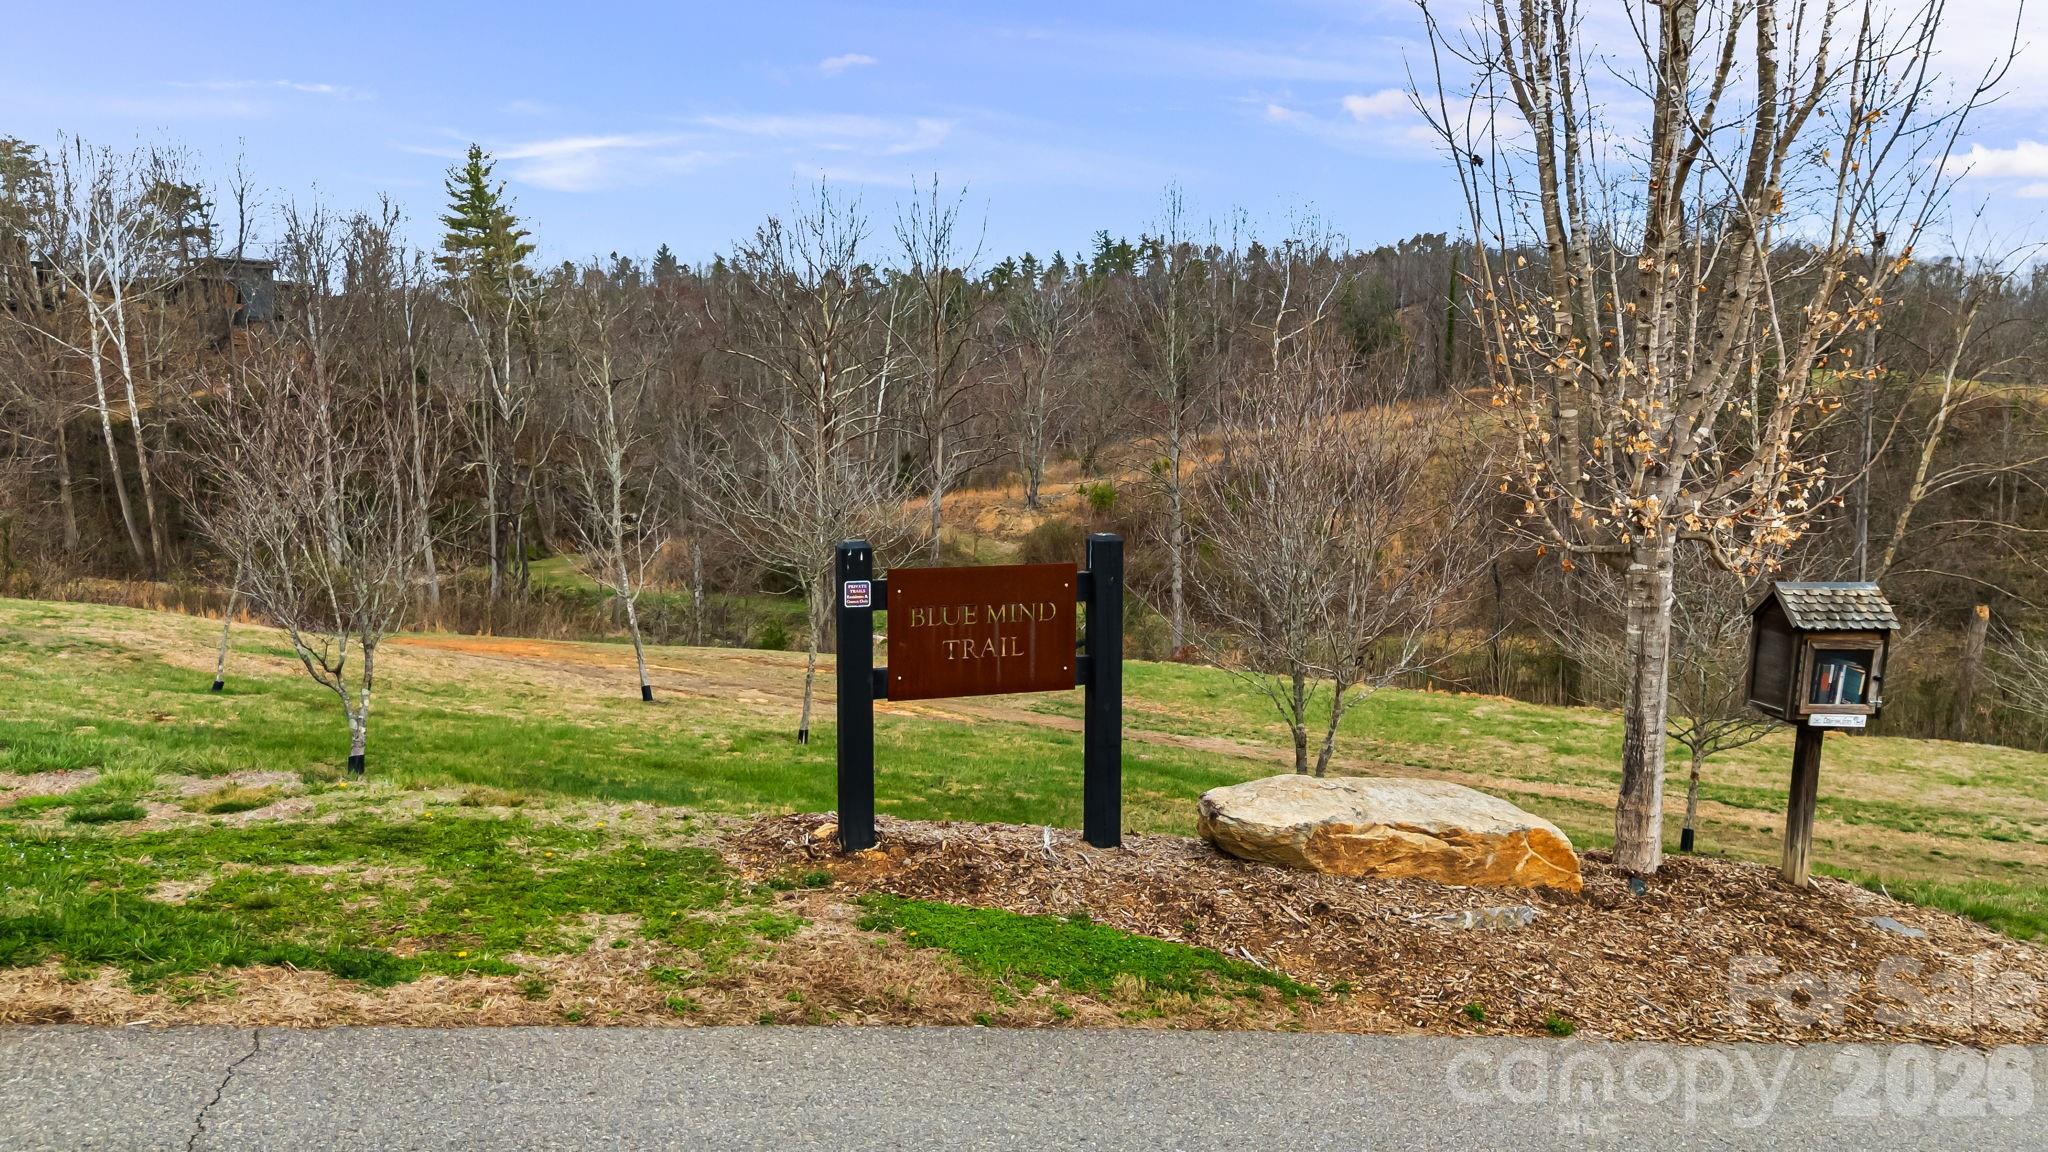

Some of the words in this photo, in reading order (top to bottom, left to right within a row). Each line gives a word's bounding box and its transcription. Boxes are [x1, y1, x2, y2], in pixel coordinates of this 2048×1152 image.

[910, 604, 978, 627] BLUE
[986, 602, 1057, 625] MIND
[943, 636, 1025, 660] TRAIL
